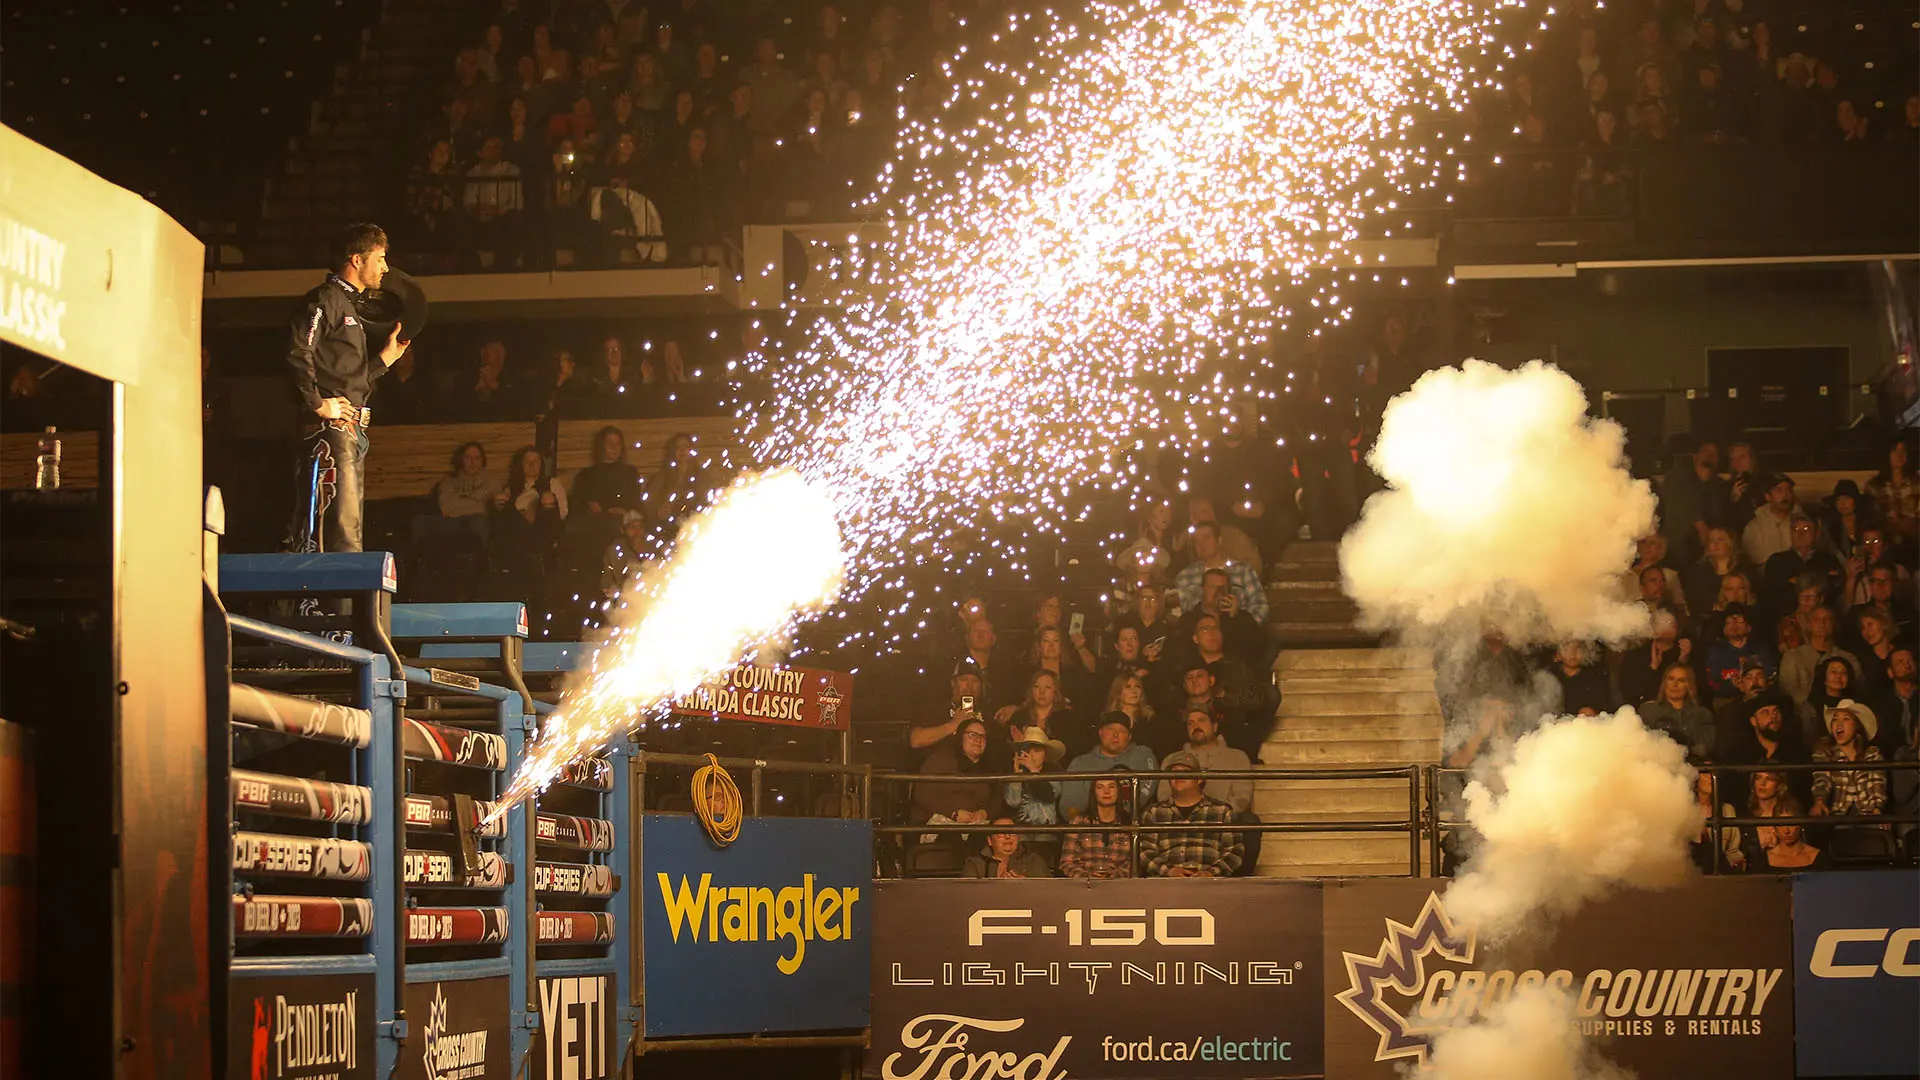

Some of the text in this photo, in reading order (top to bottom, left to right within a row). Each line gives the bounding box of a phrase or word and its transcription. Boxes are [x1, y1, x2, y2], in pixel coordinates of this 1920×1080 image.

[733, 665, 805, 694] COUNTRY
[743, 692, 805, 720] CLASSIC
[239, 782, 305, 804] PBR CANADA
[407, 801, 431, 821] PBR
[538, 819, 555, 837] PBR
[233, 839, 312, 872] CUP SERIES
[404, 855, 450, 882] CUP SERI
[535, 866, 580, 892] CUP SERIES
[657, 872, 860, 975] Wrangler
[968, 909, 1215, 946] F-150
[1576, 968, 1784, 1018] COUNTRY
[275, 991, 356, 1077] PENDLETON
[539, 976, 605, 1080] YETI
[1572, 1018, 1762, 1036] SUPPLIES & RENTALS
[881, 1013, 1073, 1080] Ford
[1102, 1035, 1292, 1062] ford.ca/electric
